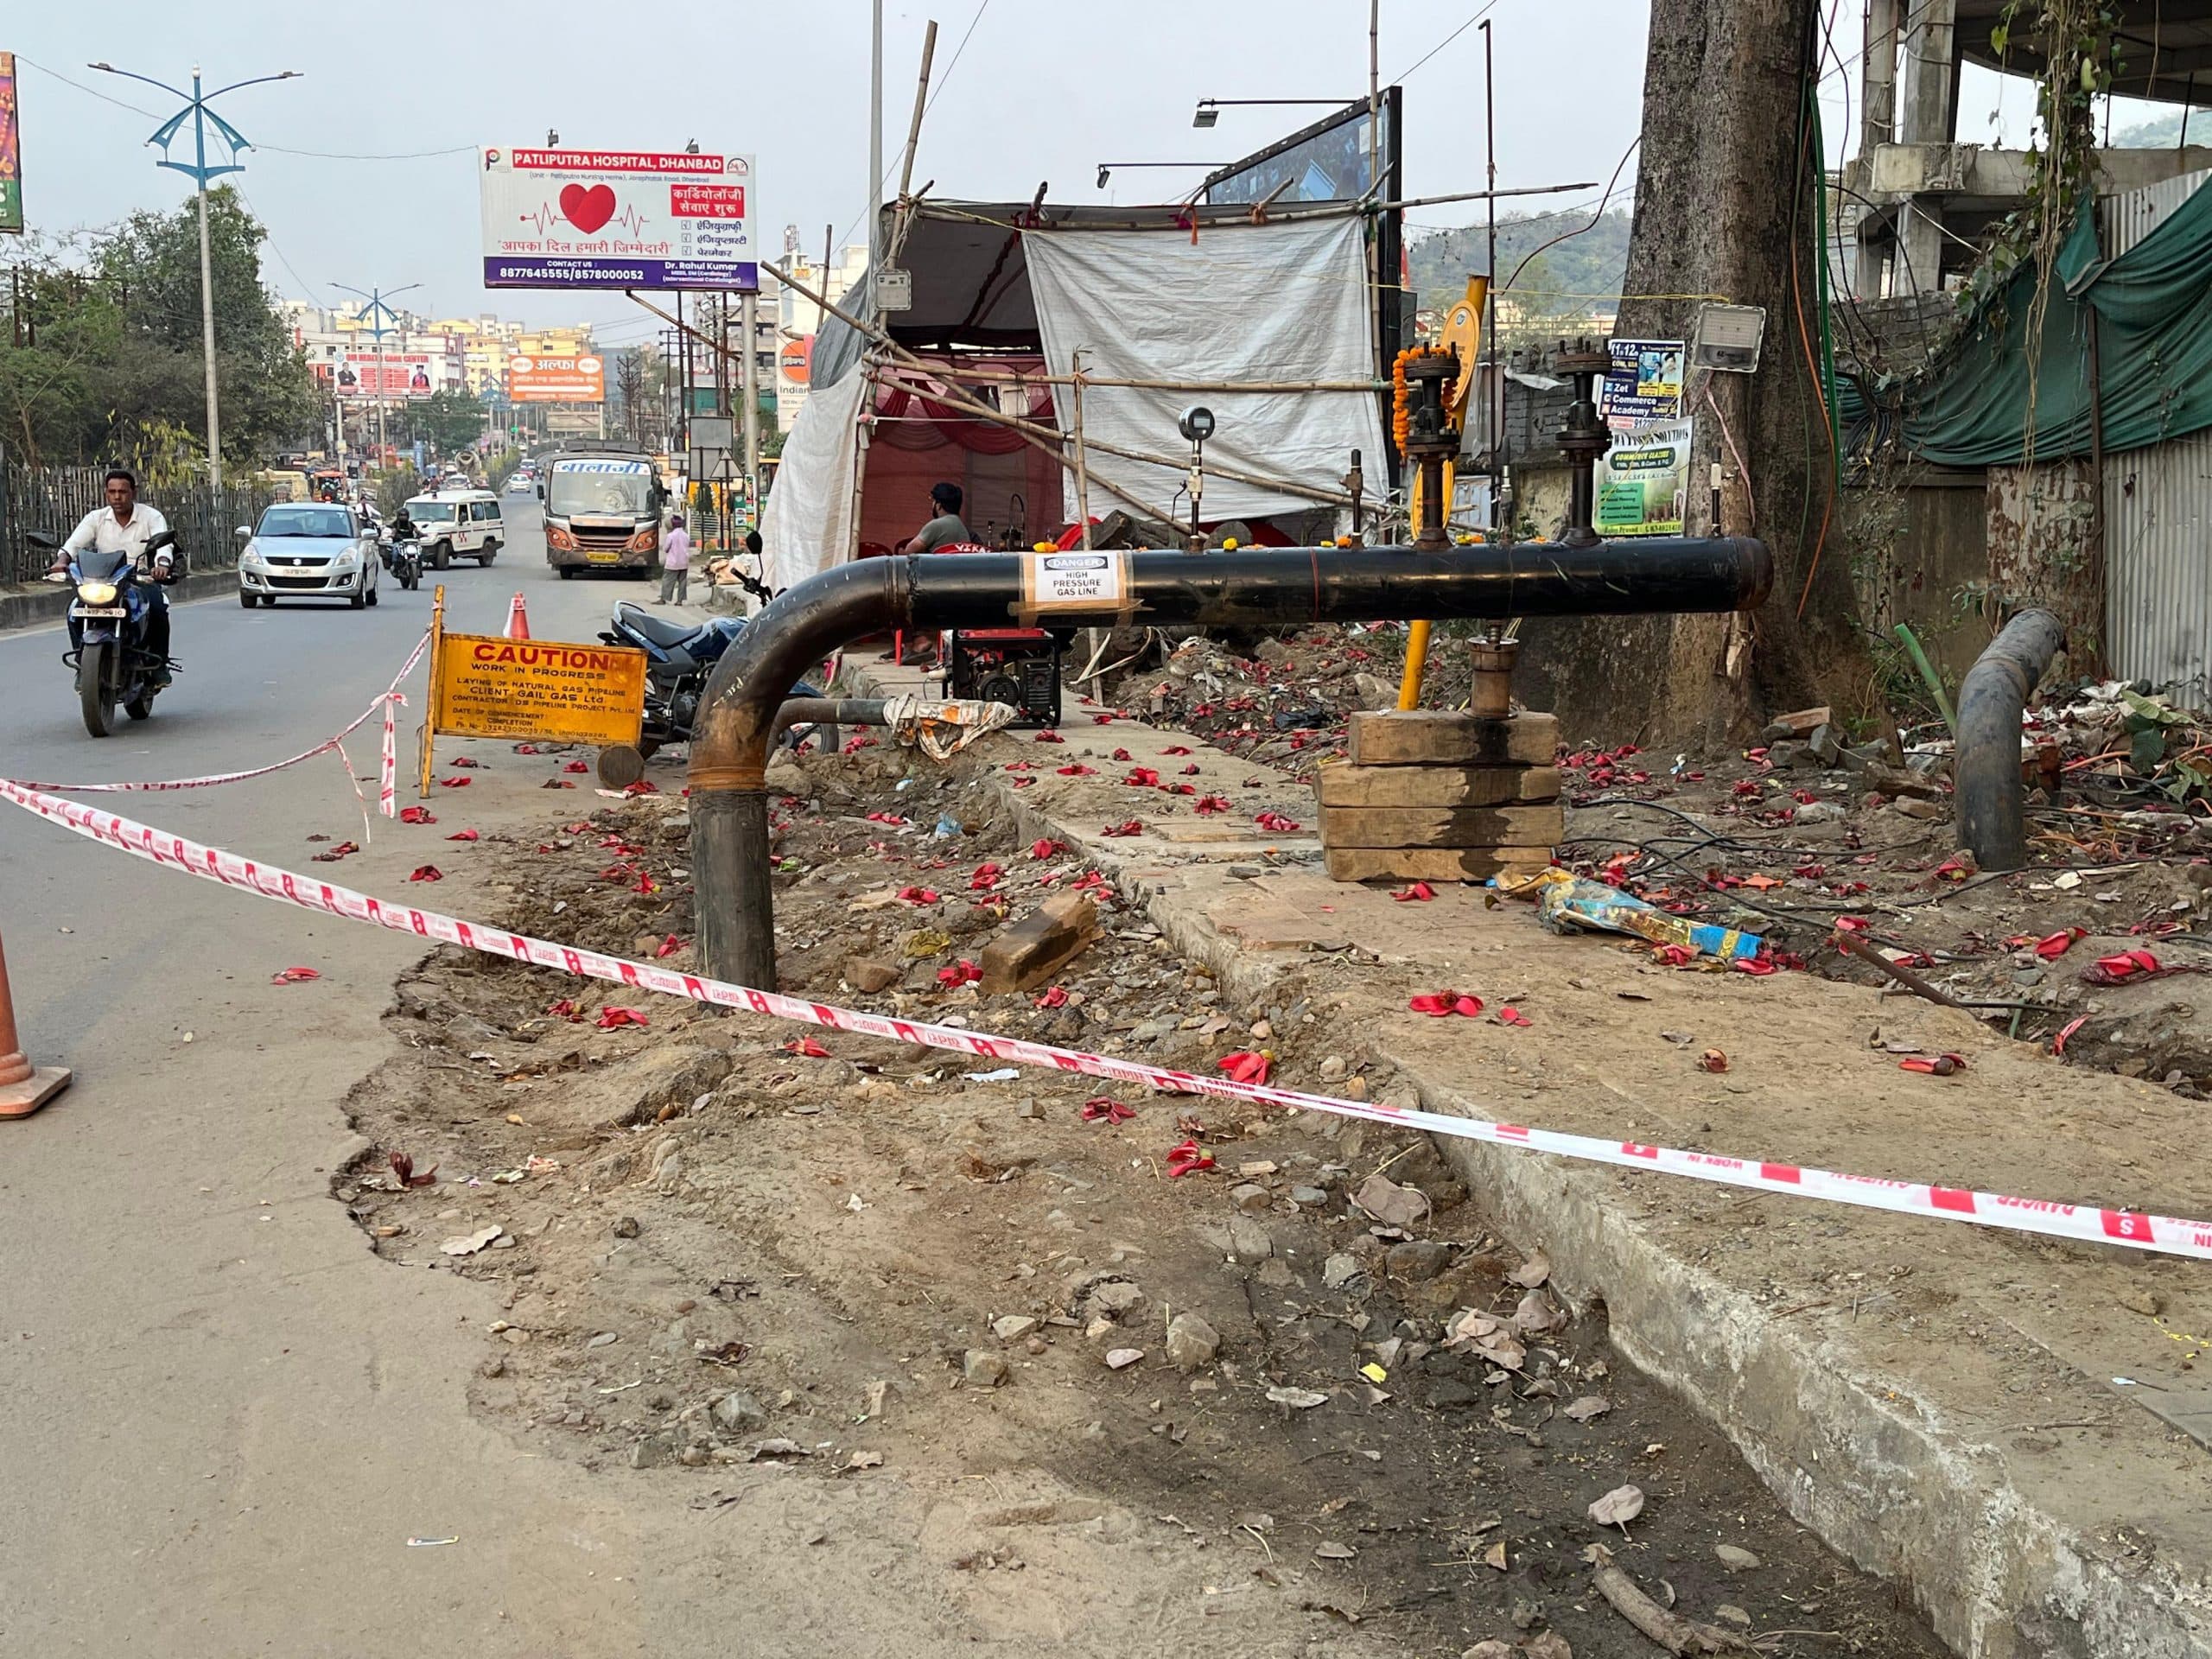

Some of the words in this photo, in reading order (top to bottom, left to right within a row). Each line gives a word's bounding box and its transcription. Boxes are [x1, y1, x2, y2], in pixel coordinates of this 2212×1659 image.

[514, 153, 591, 167] PATLIPUTRA
[594, 156, 657, 169] HOSPITAL,
[659, 158, 721, 170] DHANBAD
[673, 187, 742, 201] कार्डियोलॉजी
[715, 205, 736, 216] शुरू
[546, 238, 570, 252] दिल
[576, 240, 608, 253] हमारी
[536, 359, 575, 371] अल्फा
[1613, 384, 1628, 392] Zet
[1612, 396, 1657, 405] Commerce
[1611, 405, 1649, 417] Academy
[561, 461, 643, 474] बालाजी
[954, 543, 991, 554] VIKA
[1052, 558, 1099, 567] DANGER
[474, 644, 609, 671] CAUTION
[471, 663, 506, 672] WORK
[532, 668, 607, 680] PROGRESS
[456, 677, 492, 686] LAYING
[512, 681, 556, 691] NATURAL
[588, 688, 626, 696] PIPELINE
[452, 695, 508, 704] CONTRACTOR
[470, 686, 510, 696] CLIENT
[518, 690, 545, 699] GAIL
[550, 692, 578, 702] GAS
[1703, 1156, 1743, 1170] WORK
